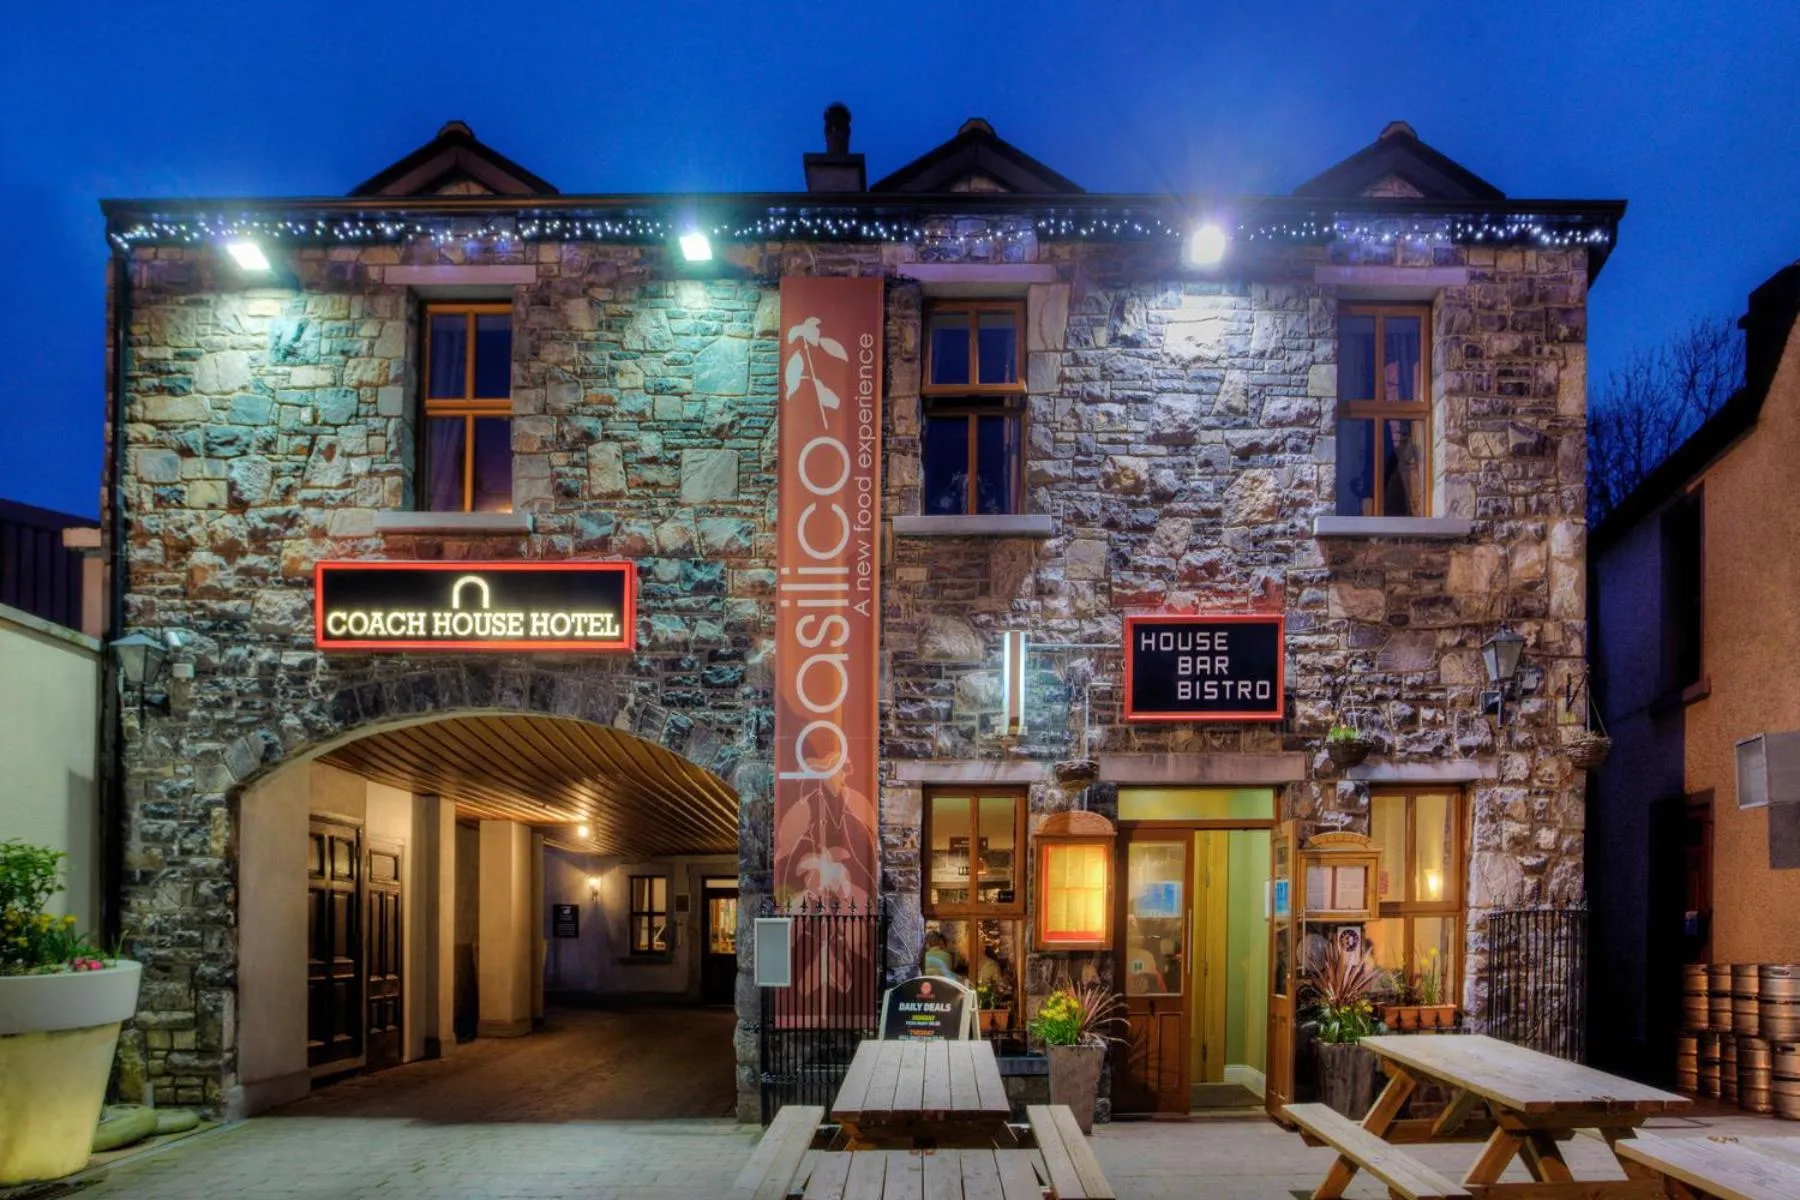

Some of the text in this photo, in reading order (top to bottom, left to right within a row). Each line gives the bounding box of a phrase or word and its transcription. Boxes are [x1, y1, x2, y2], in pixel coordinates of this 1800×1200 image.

[853, 332, 876, 617] A new food experience
[779, 436, 850, 780] basilico
[326, 611, 620, 637] COACH HOUSE HOTEL
[1141, 632, 1229, 651] HOUSE
[1177, 656, 1230, 675] BAR
[1177, 680, 1270, 700] BISTRO
[898, 1002, 952, 1012] DAILY DEALS
